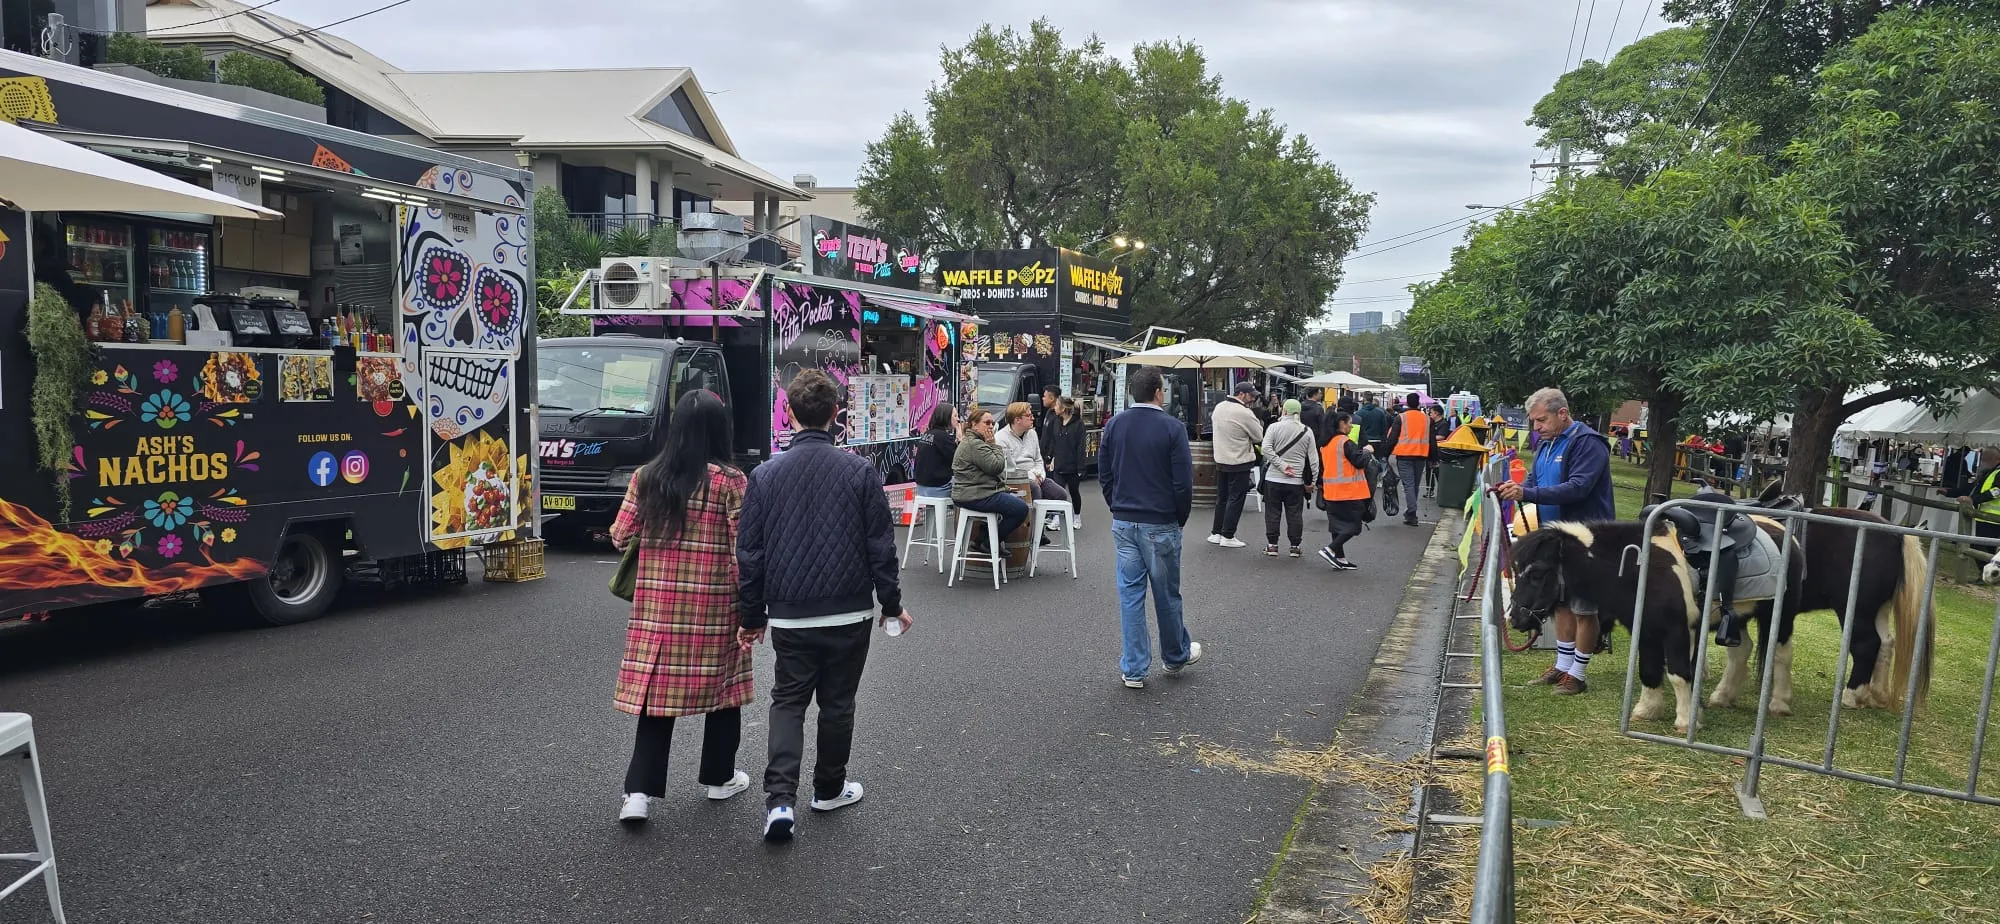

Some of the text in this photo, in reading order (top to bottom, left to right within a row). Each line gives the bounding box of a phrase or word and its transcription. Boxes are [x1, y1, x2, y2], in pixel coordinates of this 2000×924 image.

[217, 172, 257, 188] PICK UP
[448, 211, 471, 222] ORDER
[453, 223, 469, 234] HERE
[847, 234, 889, 264] TETA'S
[942, 269, 1003, 287] WAFFLE
[1070, 264, 1101, 291] WAFFLE
[987, 288, 1015, 299] DONUTS
[1021, 287, 1048, 299] SHAKES
[774, 295, 834, 355] Pitta Pockets
[544, 423, 586, 433] ISUZU
[136, 435, 195, 456] ASH'S
[298, 433, 353, 443] FOLLOW US ON:
[573, 441, 609, 458] Pitta
[98, 453, 228, 487] NACHOS
